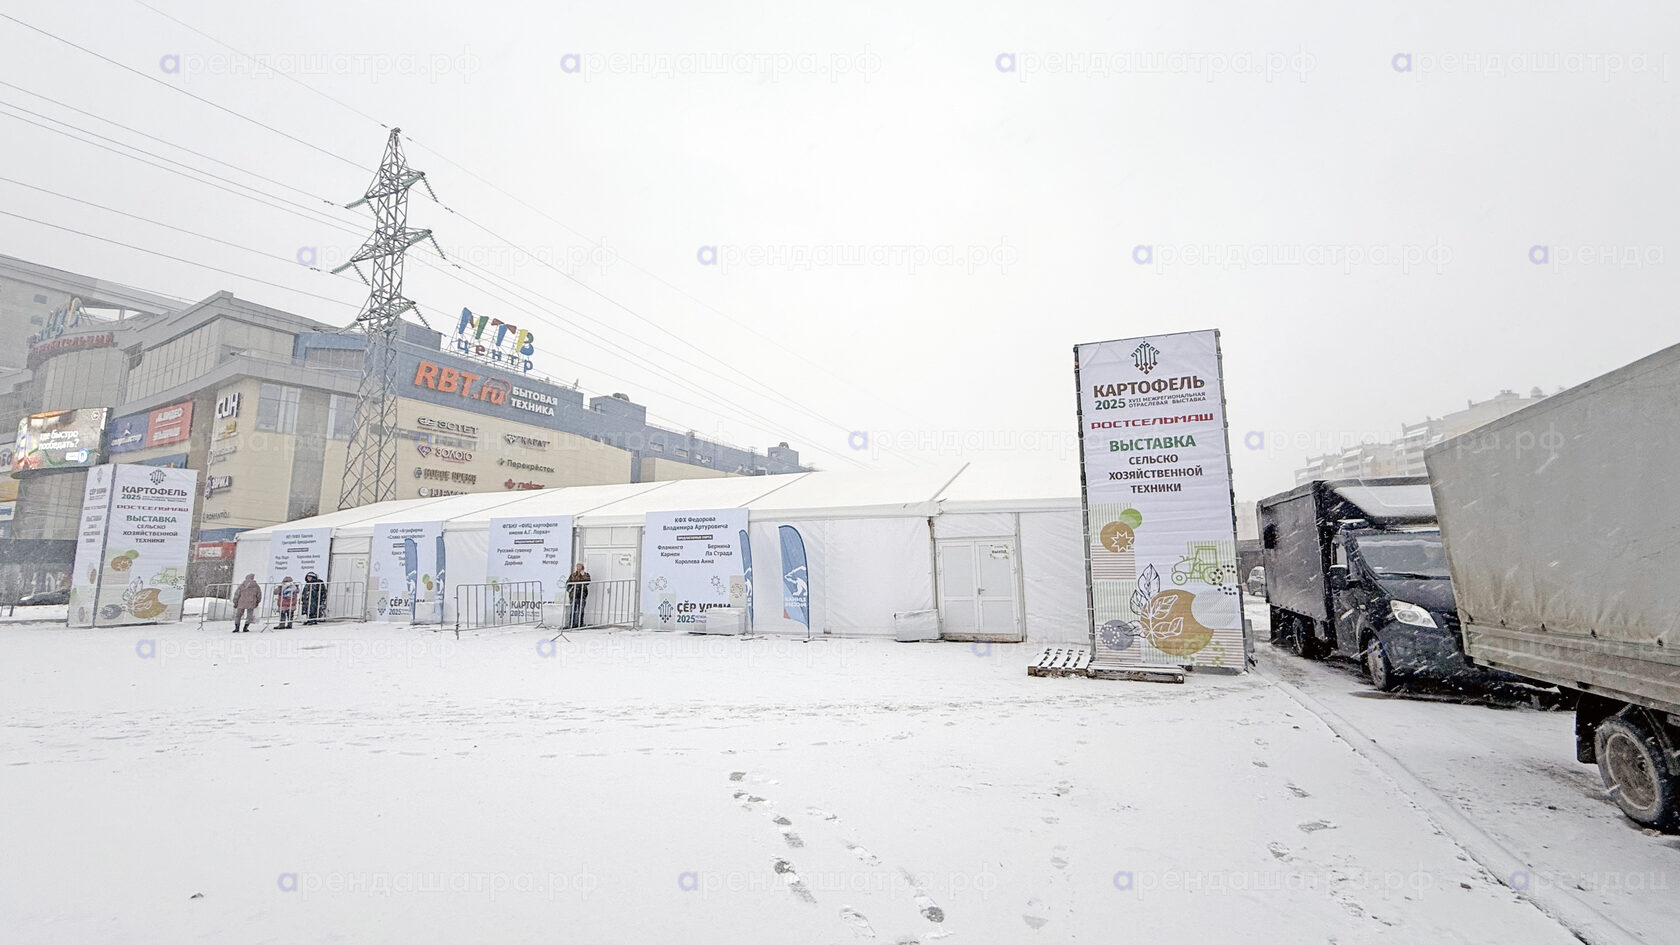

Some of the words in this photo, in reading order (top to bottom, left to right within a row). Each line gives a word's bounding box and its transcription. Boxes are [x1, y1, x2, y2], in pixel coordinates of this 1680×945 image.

[457, 338, 533, 373] центр
[414, 361, 506, 405] RBT.ru
[1093, 375, 1205, 398] КАРТОФЕЛЬ
[512, 386, 558, 405] БЫТОВАЯ
[1095, 398, 1126, 410] 2025
[1142, 391, 1206, 401] МЕЖРЕГИОНАЛЬНАЯ
[1172, 396, 1206, 404] ВЫСТАВКА
[511, 397, 555, 416] ТЕХНИКА
[1091, 413, 1214, 430] РОСТСЕЛЬМАШ
[50, 429, 79, 440] быстро
[39, 439, 79, 450] пообедать?
[1109, 434, 1196, 452] ВЫСТАВКА
[1129, 454, 1178, 465] СЕЛЬСКО
[1109, 465, 1203, 480] ХОЗЯЙСТВЕННОЙ
[122, 485, 188, 497] КАРТОФЕЛЬ
[1130, 483, 1182, 494] ТЕХНИКИ
[126, 514, 177, 523] ВЫСТАВКА
[676, 614, 696, 623] 2025
